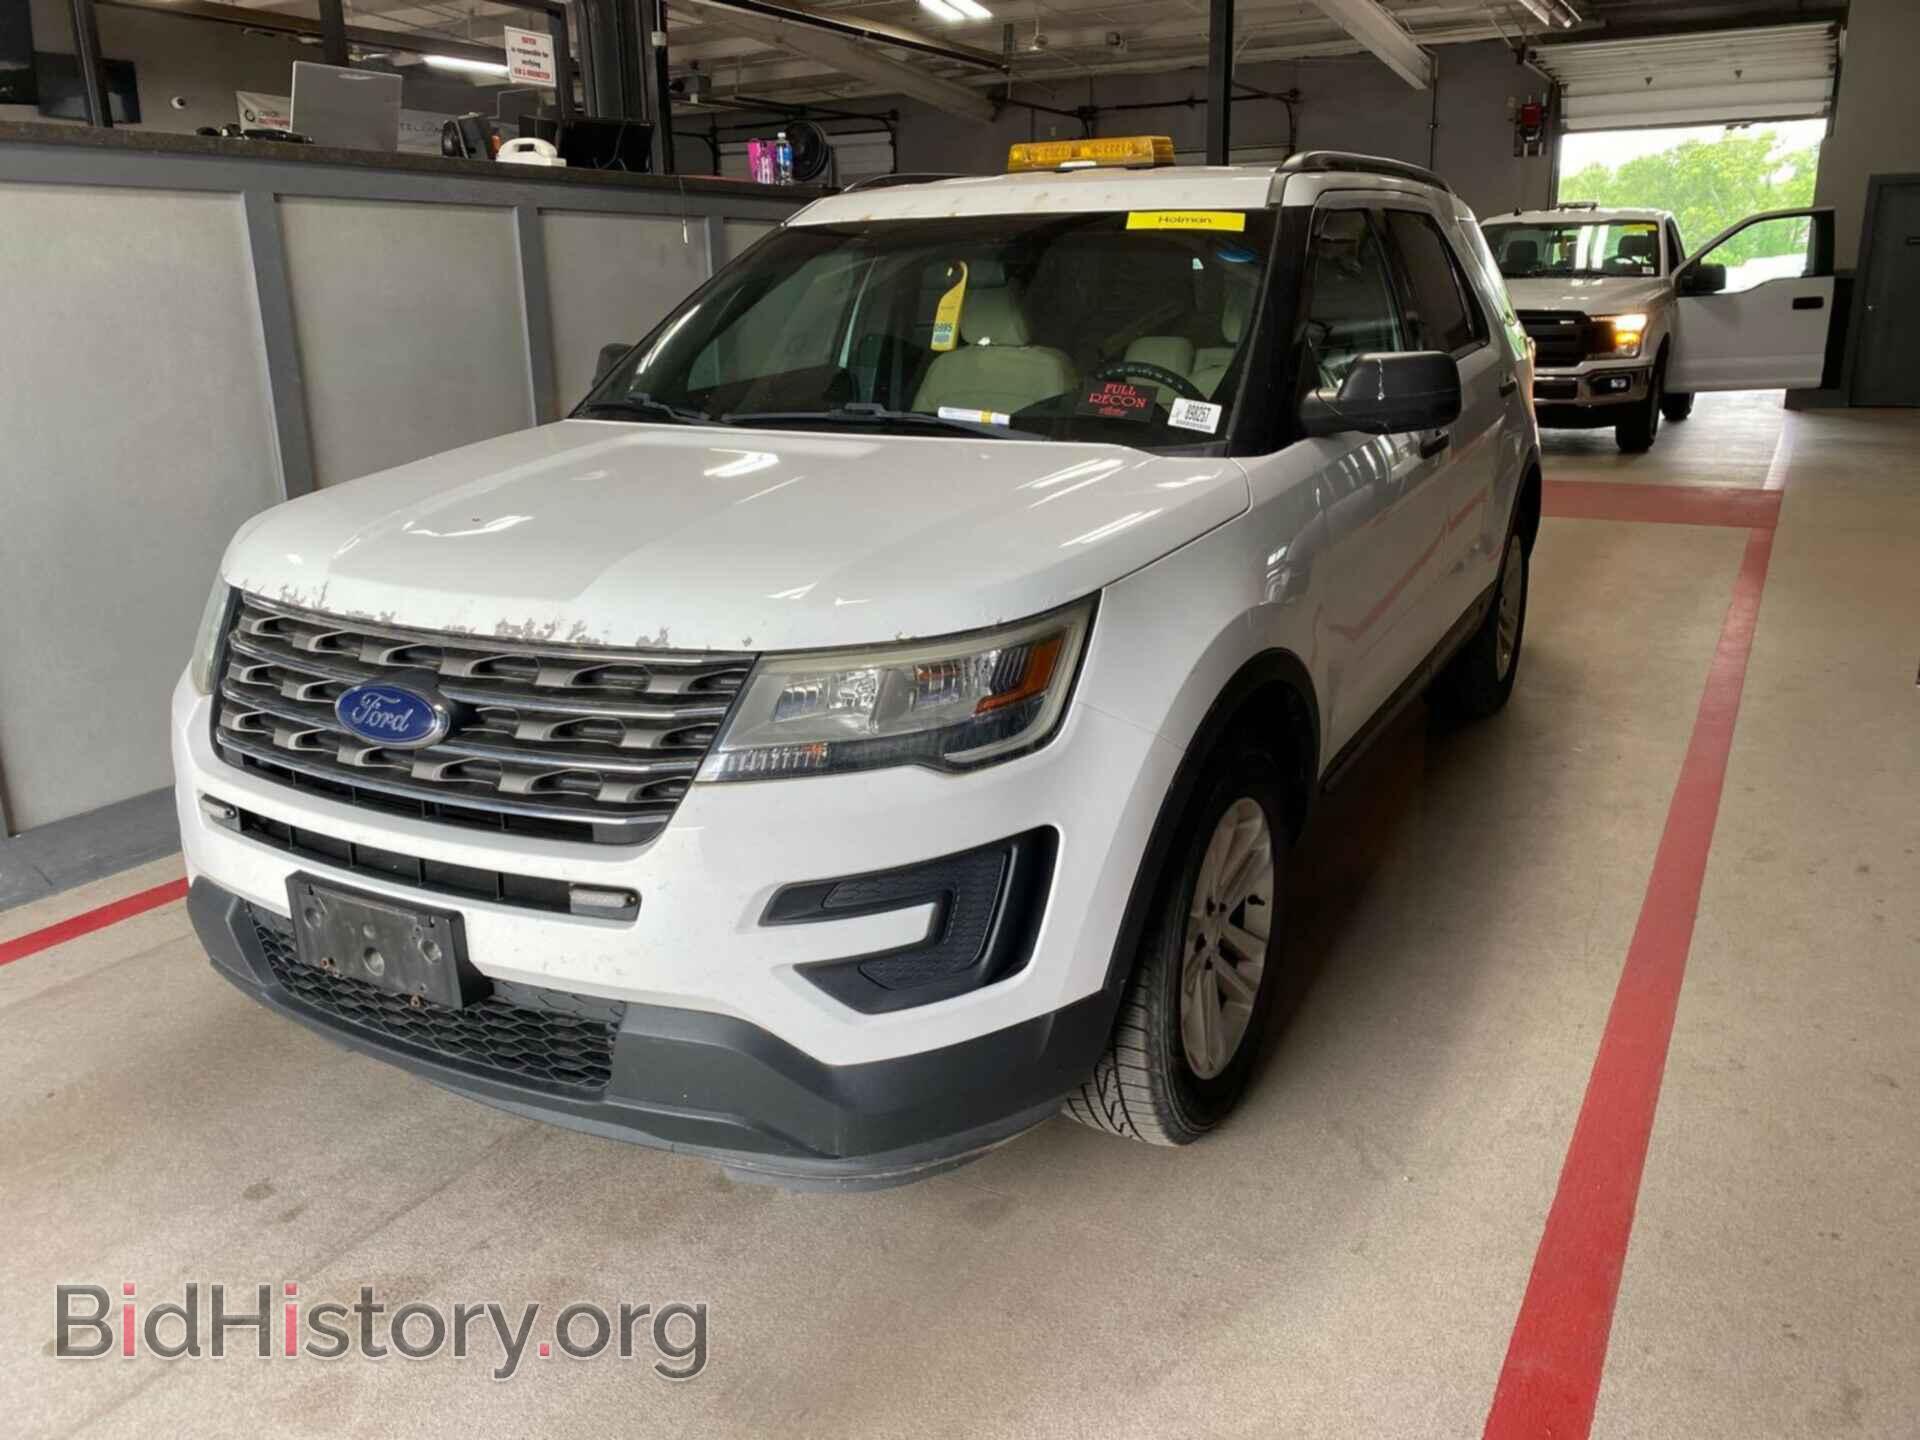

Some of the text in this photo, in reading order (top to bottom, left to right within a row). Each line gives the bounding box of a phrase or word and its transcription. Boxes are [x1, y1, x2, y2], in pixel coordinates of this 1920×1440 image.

[1158, 214, 1212, 224] Holman
[1104, 383, 1137, 396] FULL
[1088, 393, 1148, 409] RECON
[352, 692, 414, 733] Ford
